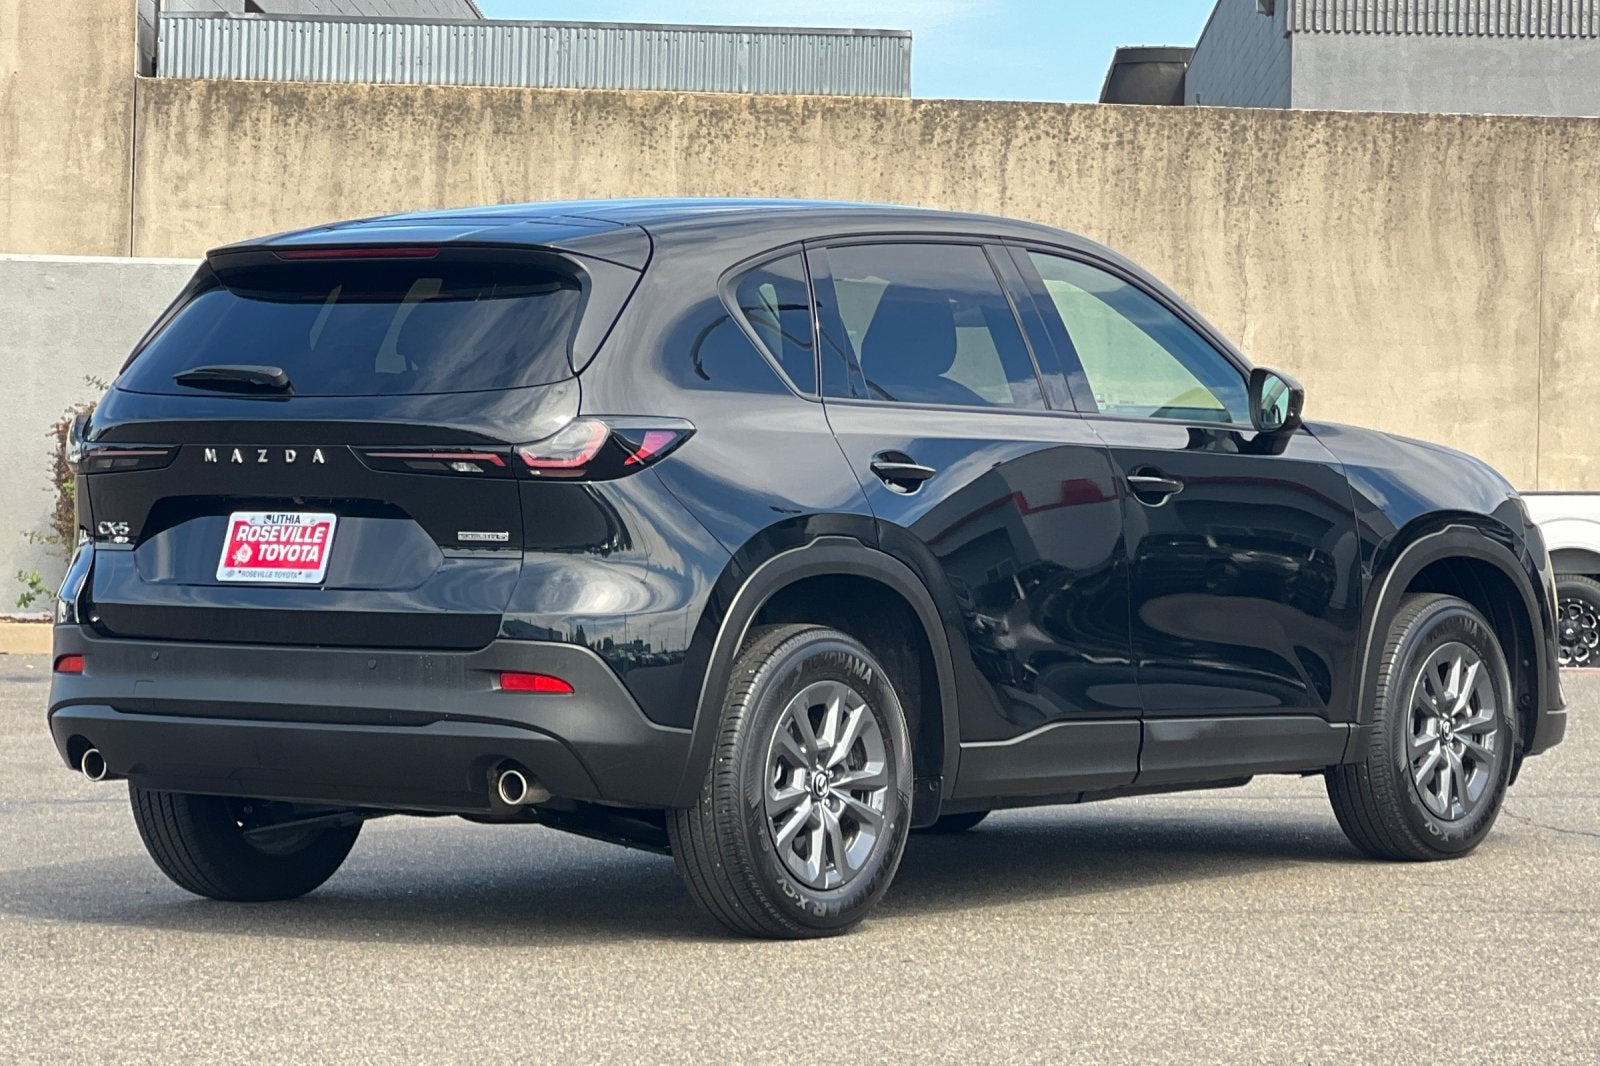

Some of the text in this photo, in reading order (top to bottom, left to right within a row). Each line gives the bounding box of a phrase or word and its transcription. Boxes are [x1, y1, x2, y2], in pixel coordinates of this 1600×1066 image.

[204, 447, 326, 464] MAZDA
[271, 514, 301, 524] LITHIA
[97, 521, 130, 535] CX-5
[235, 525, 326, 543] ROSEVILLE
[257, 543, 319, 563] TOYOTA
[241, 570, 298, 579] ROSEVILLE TOYOTA
